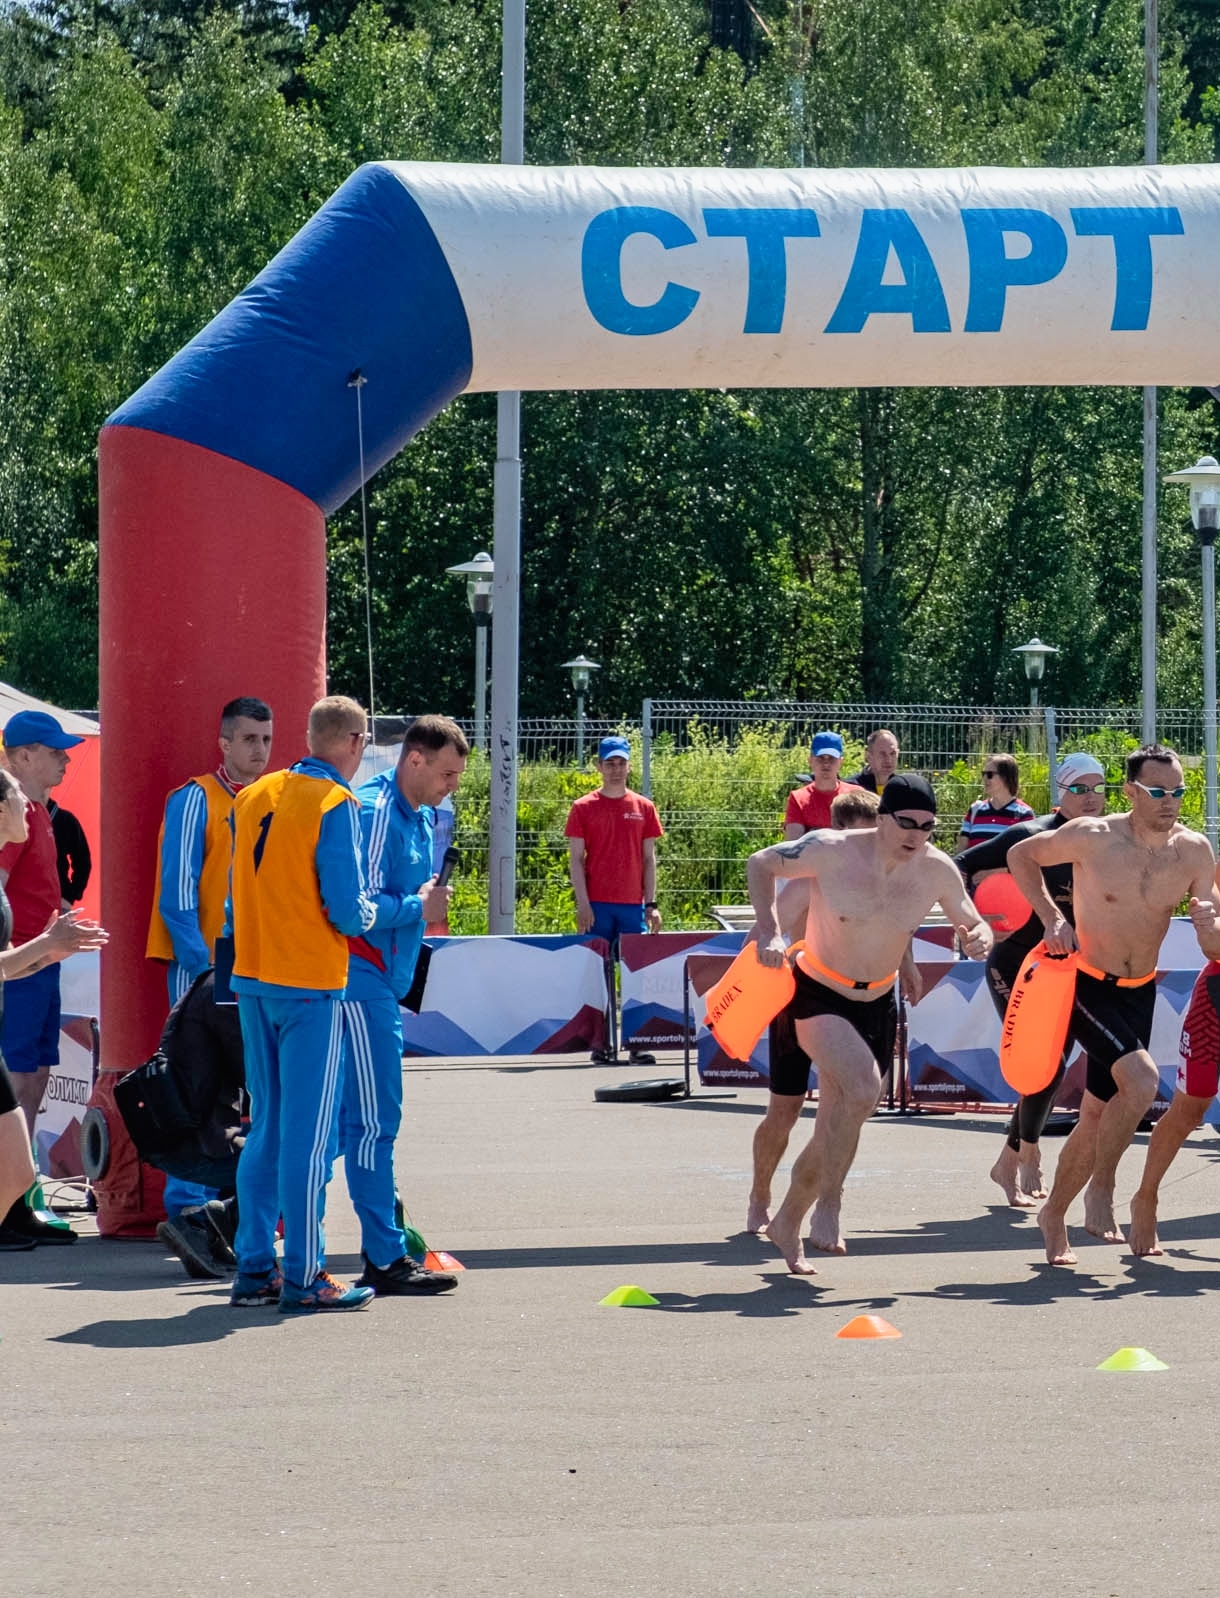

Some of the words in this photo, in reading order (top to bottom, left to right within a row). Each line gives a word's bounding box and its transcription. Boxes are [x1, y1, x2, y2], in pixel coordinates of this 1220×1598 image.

[581, 206, 1186, 335] СТАРТ
[712, 985, 744, 1024] BRADEX
[1003, 990, 1025, 1050] BRADEX
